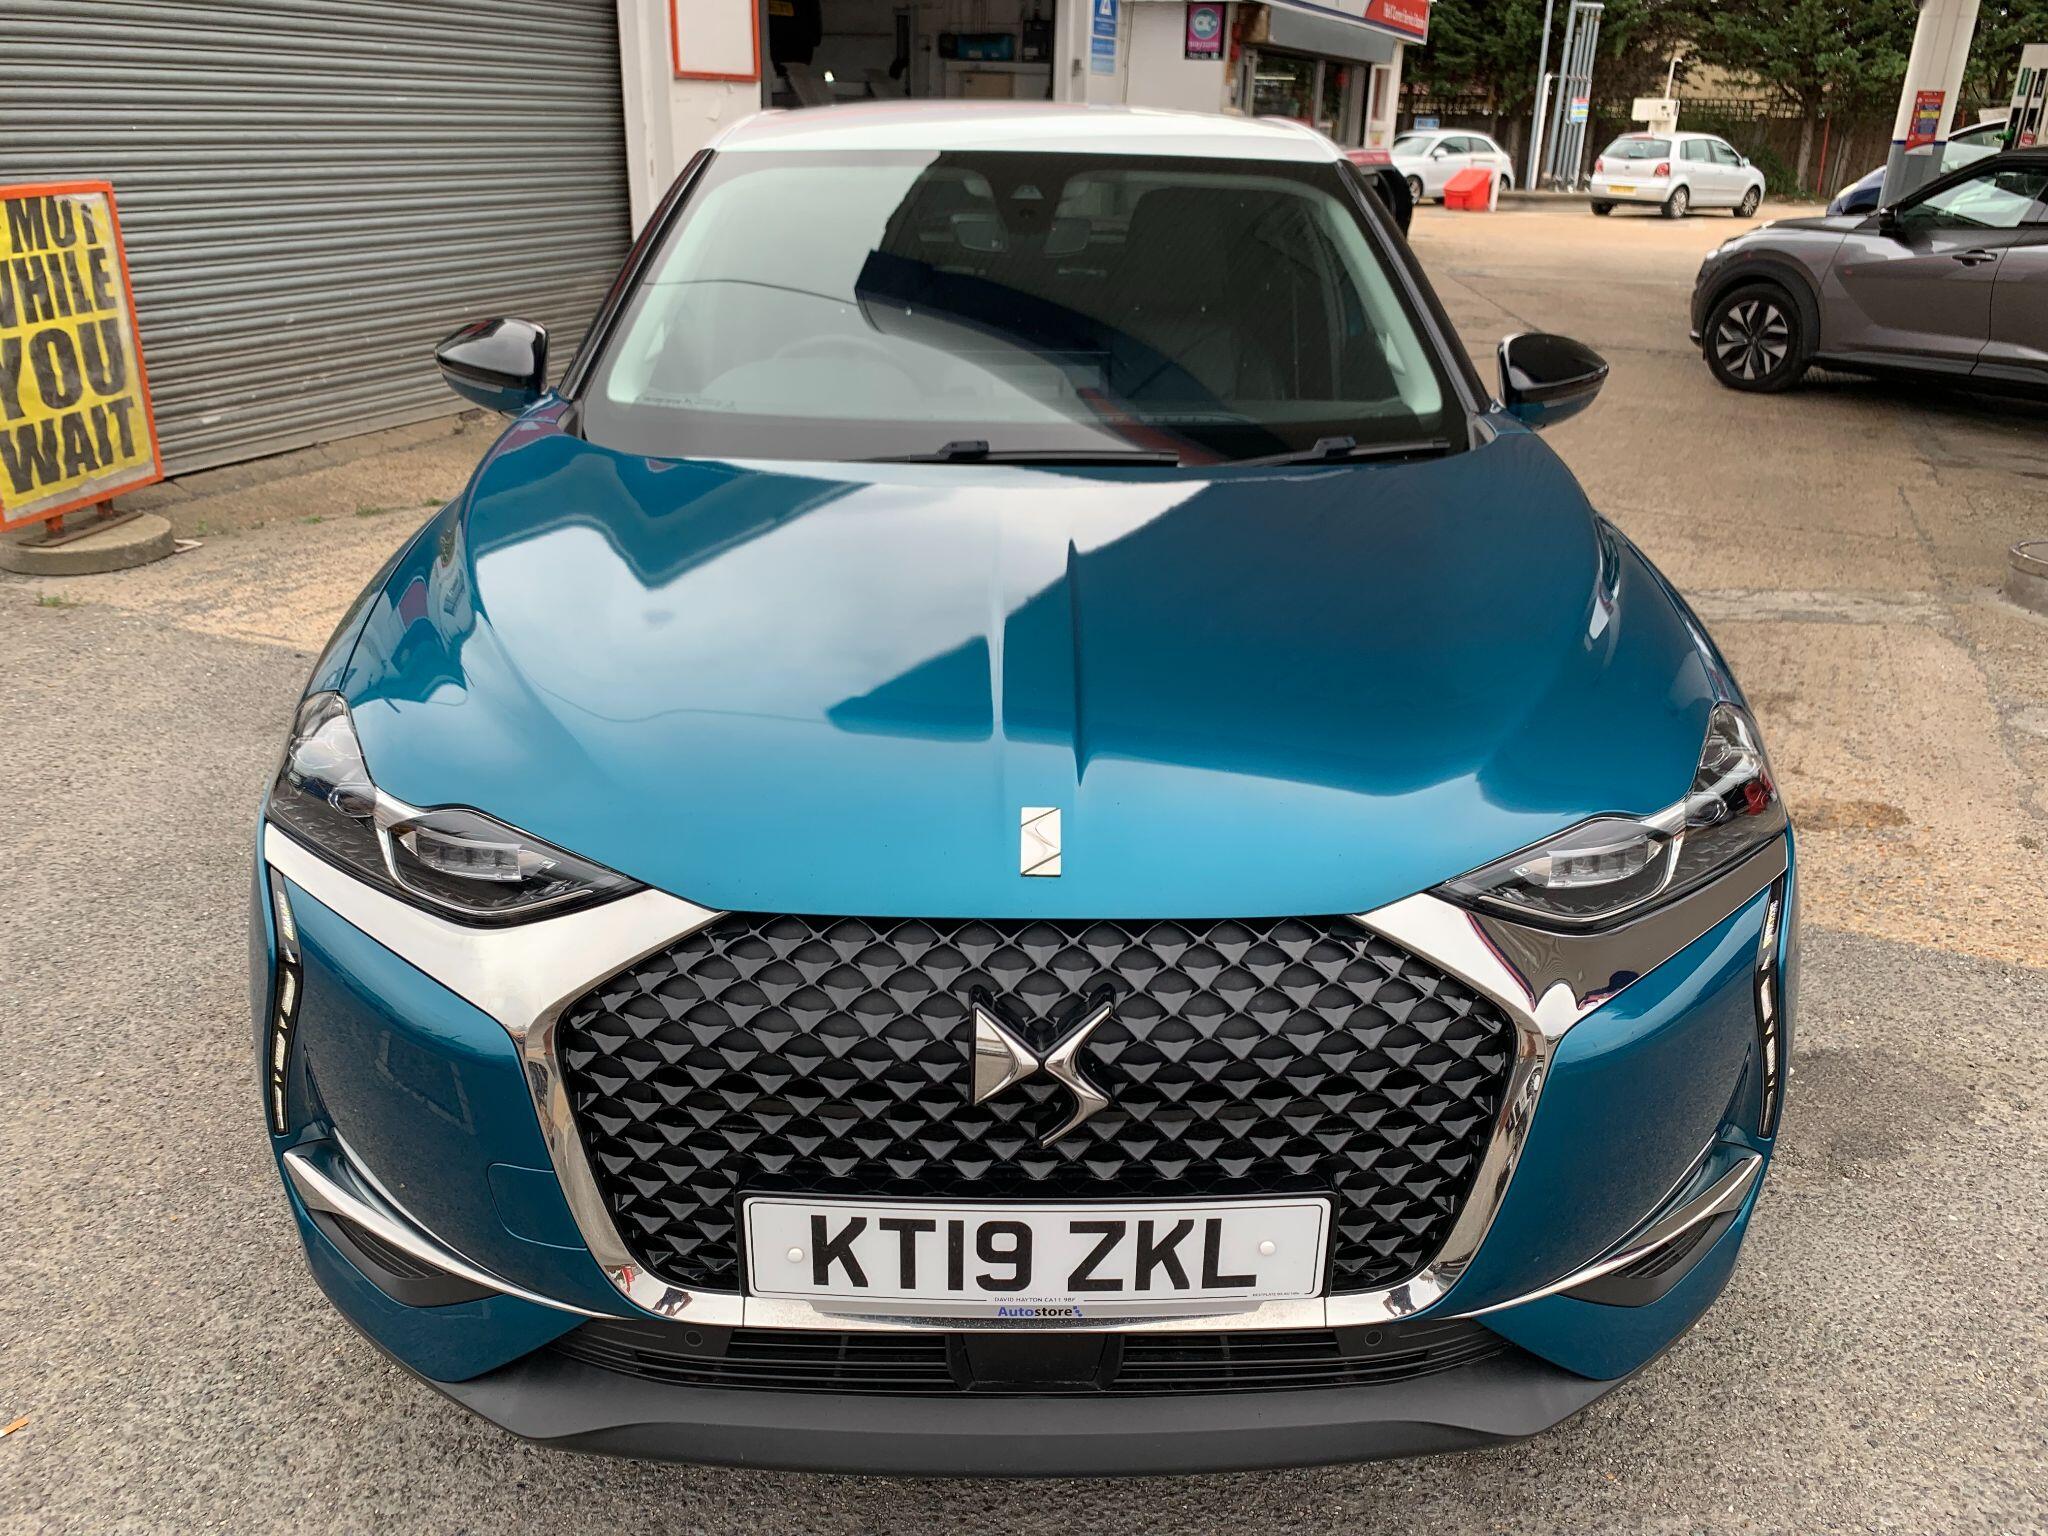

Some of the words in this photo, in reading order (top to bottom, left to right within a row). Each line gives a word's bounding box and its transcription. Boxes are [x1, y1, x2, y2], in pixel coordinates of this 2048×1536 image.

[0, 317, 126, 420] YOU
[0, 396, 136, 494] WAIT
[809, 1214, 1033, 1292] KT19
[1066, 1217, 1258, 1292] ZKL
[997, 1306, 1073, 1317] Autostore
